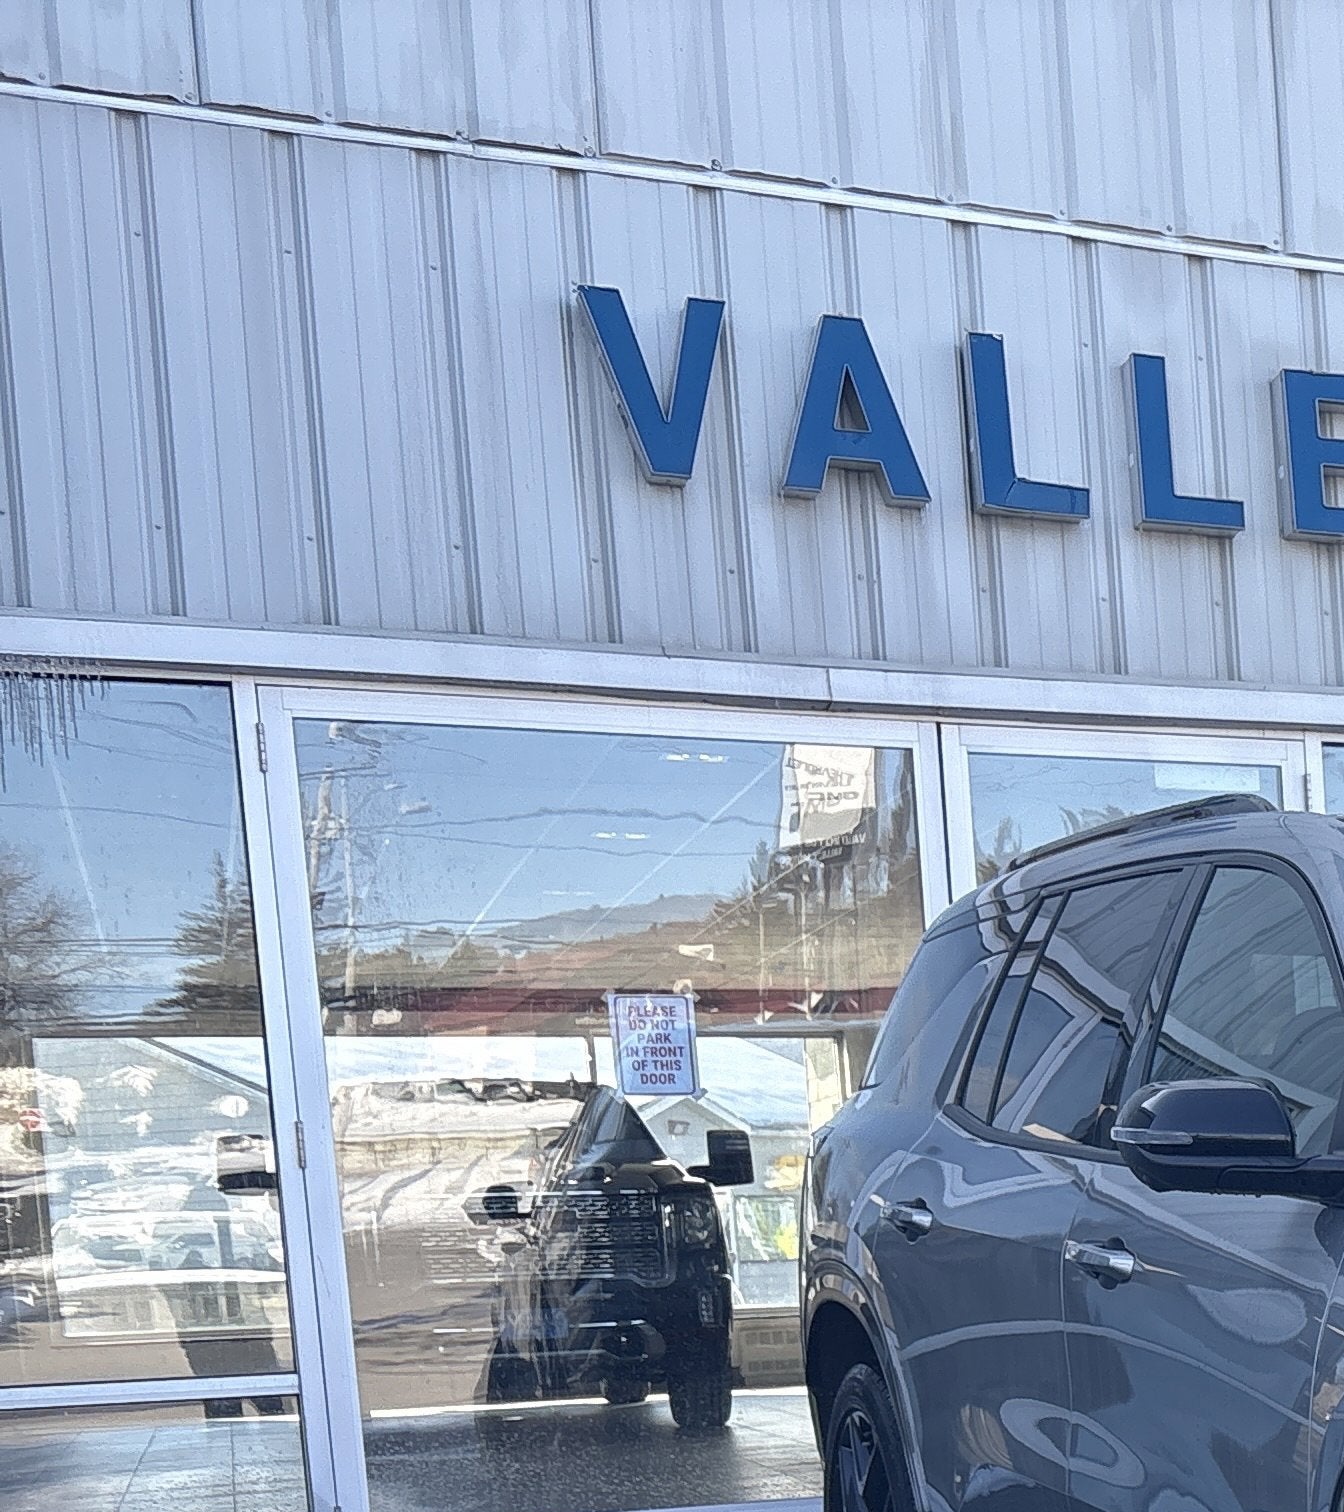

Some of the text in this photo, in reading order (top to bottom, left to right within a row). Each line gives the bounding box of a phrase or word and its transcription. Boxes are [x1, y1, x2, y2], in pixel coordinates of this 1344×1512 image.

[627, 1005, 677, 1017] PLEASE
[628, 1019, 677, 1031] DO NOT
[637, 1033, 673, 1045] PARK
[625, 1046, 685, 1058] IN FRONT
[631, 1059, 682, 1072] OF THIS
[640, 1073, 677, 1085] DOOR
